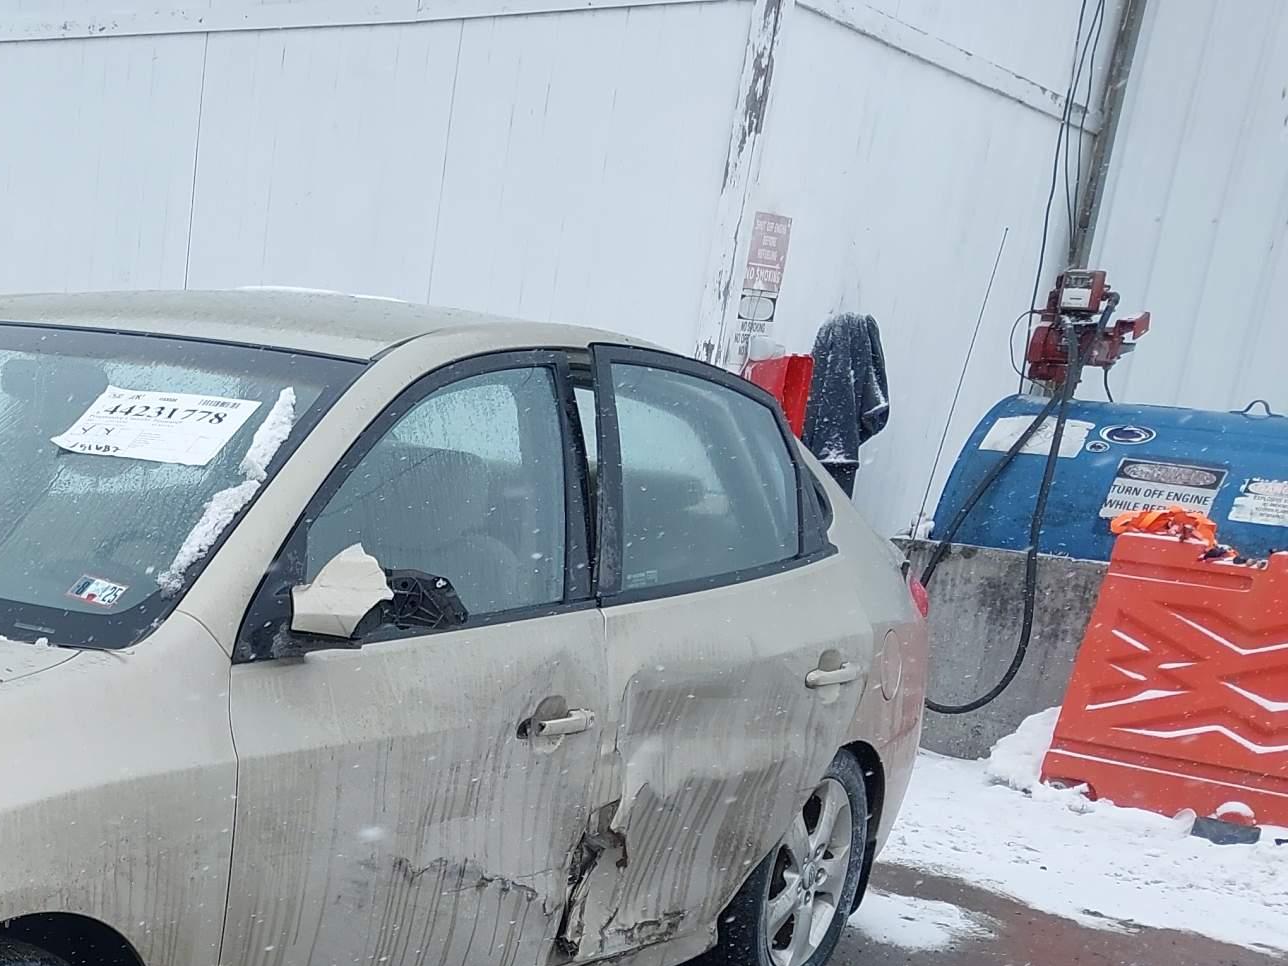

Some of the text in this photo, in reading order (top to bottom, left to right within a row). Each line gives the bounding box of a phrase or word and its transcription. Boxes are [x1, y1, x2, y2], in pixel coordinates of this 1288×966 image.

[746, 267, 781, 284] NO SMOKING
[104, 403, 227, 425] 44231778
[1111, 484, 1211, 506] TURN OFF ENGINE
[1103, 499, 1141, 511] WHILE
[102, 586, 123, 603] 25
